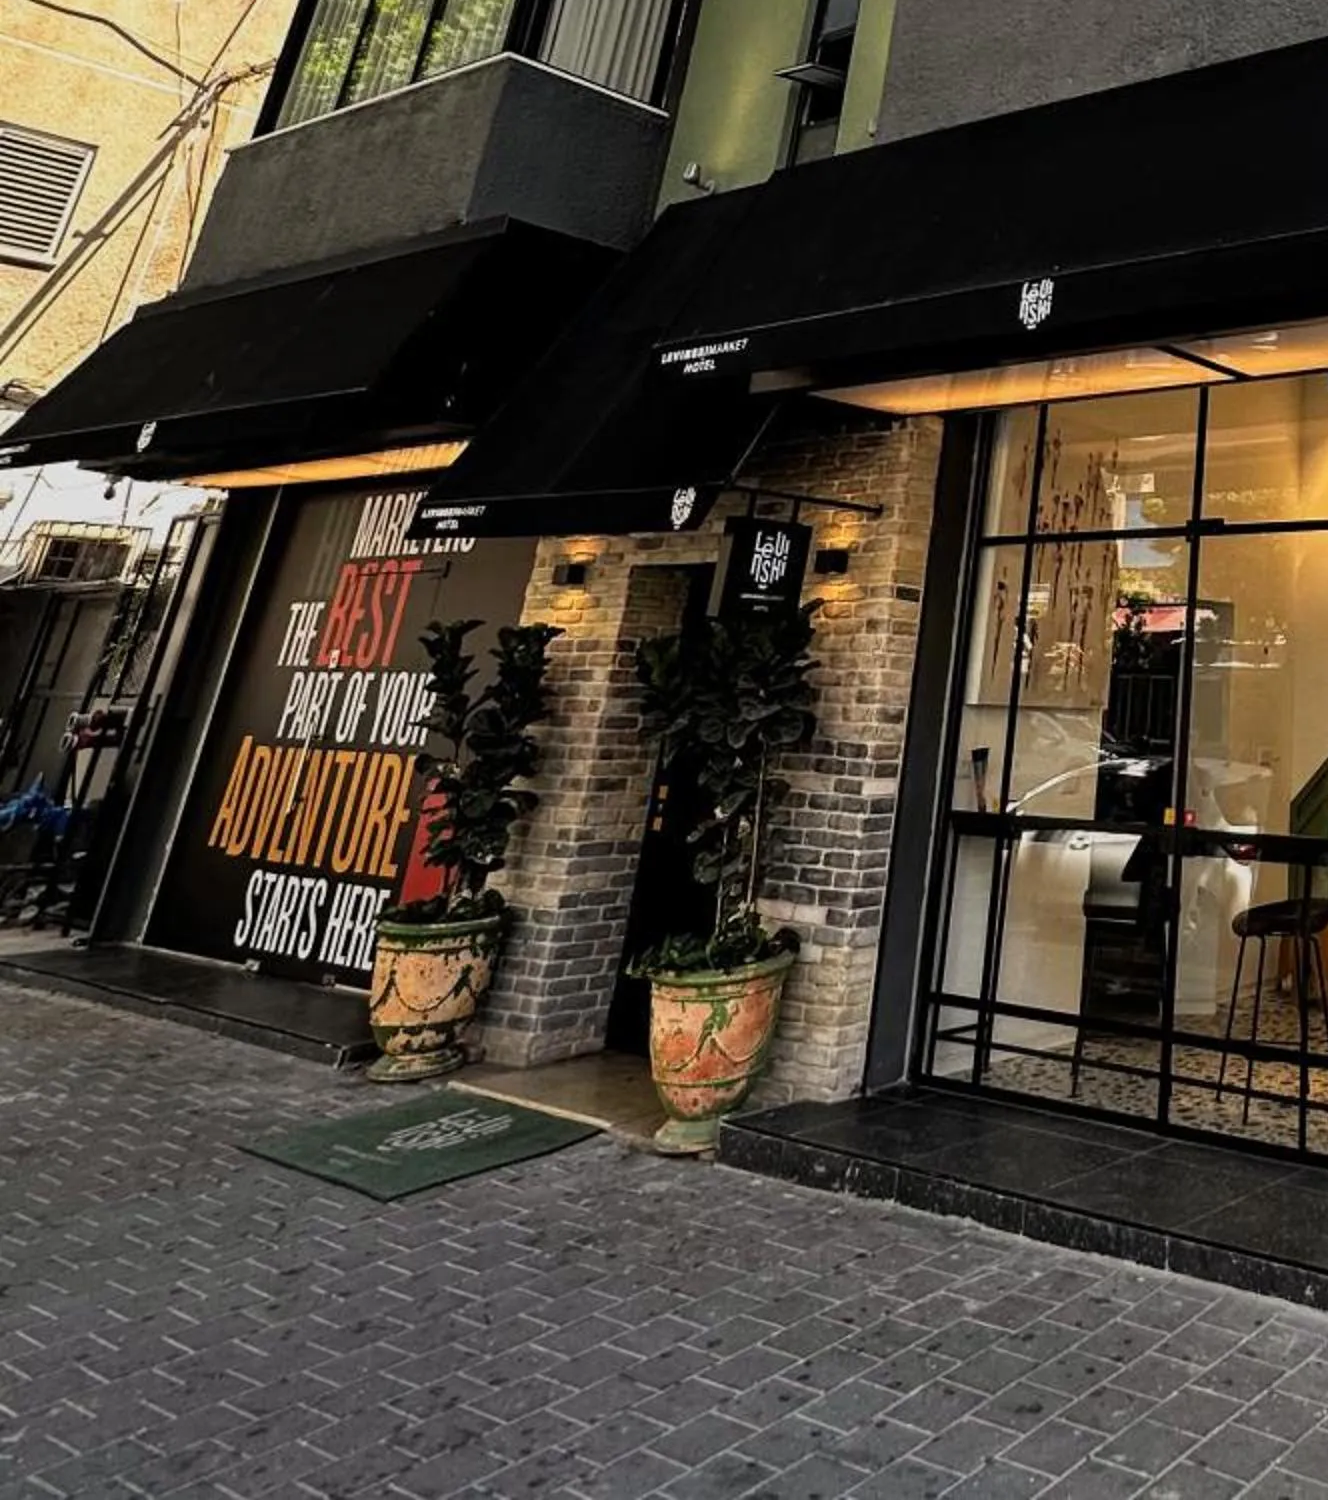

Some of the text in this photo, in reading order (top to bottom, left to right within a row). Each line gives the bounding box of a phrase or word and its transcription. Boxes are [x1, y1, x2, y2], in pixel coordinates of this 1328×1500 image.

[277, 559, 424, 669] THE BEST
[275, 671, 438, 747] PART OF YOUR
[207, 734, 416, 878] ADVENTURE
[233, 869, 329, 961] STARTS
